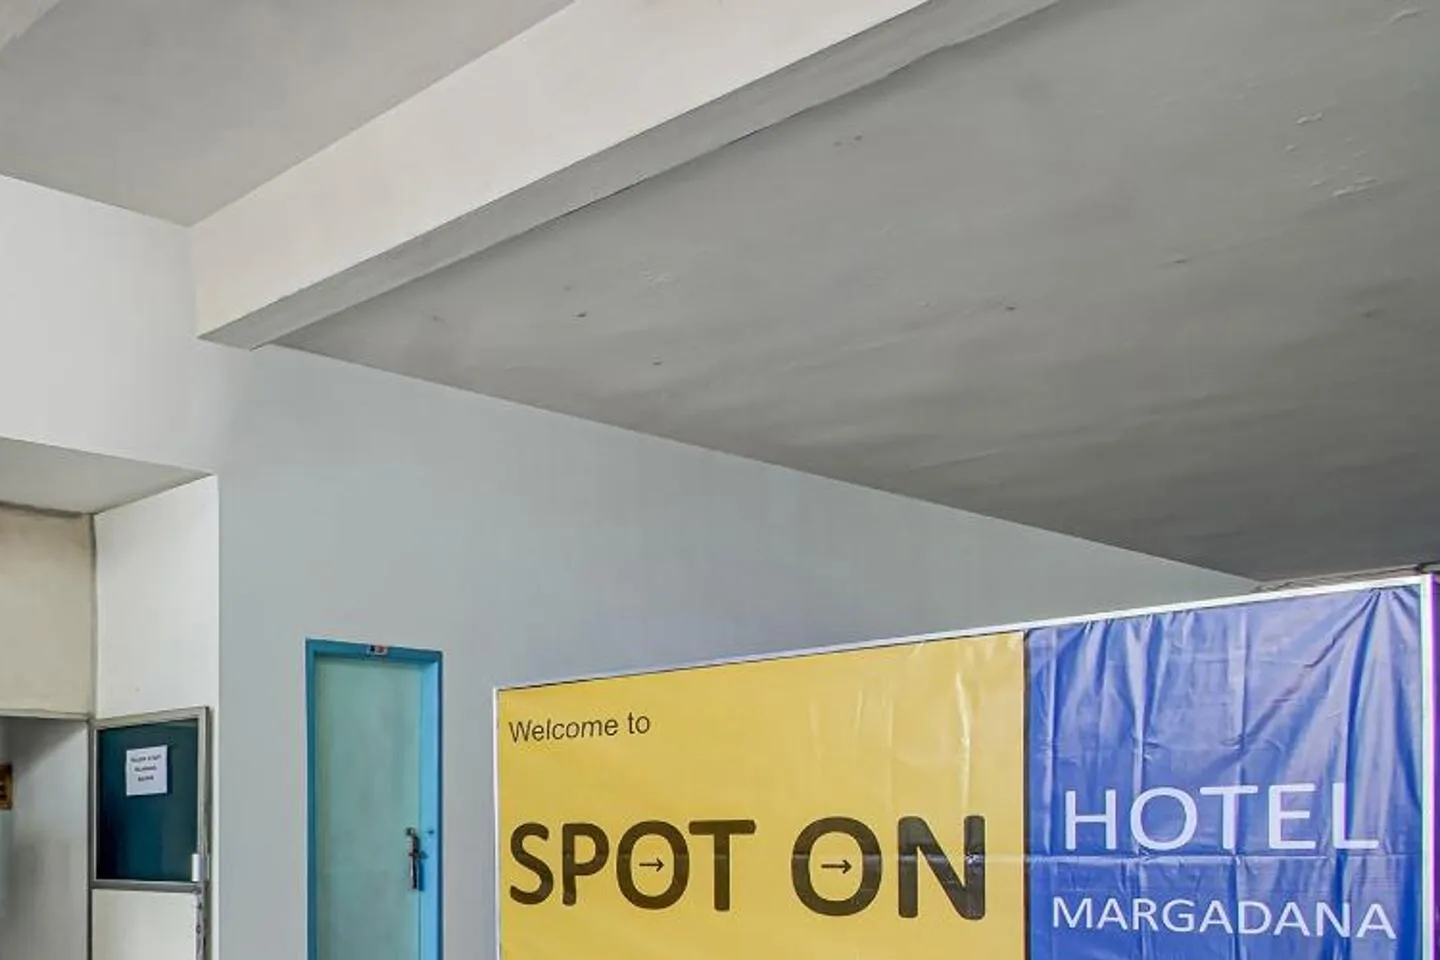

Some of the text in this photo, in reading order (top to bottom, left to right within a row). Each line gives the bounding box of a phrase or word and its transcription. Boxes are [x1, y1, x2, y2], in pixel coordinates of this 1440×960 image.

[508, 712, 651, 744] Welcome to
[1063, 781, 1380, 852] HOTEL
[508, 814, 987, 921] SPOT ON
[1051, 896, 1398, 940] MARGADANA
